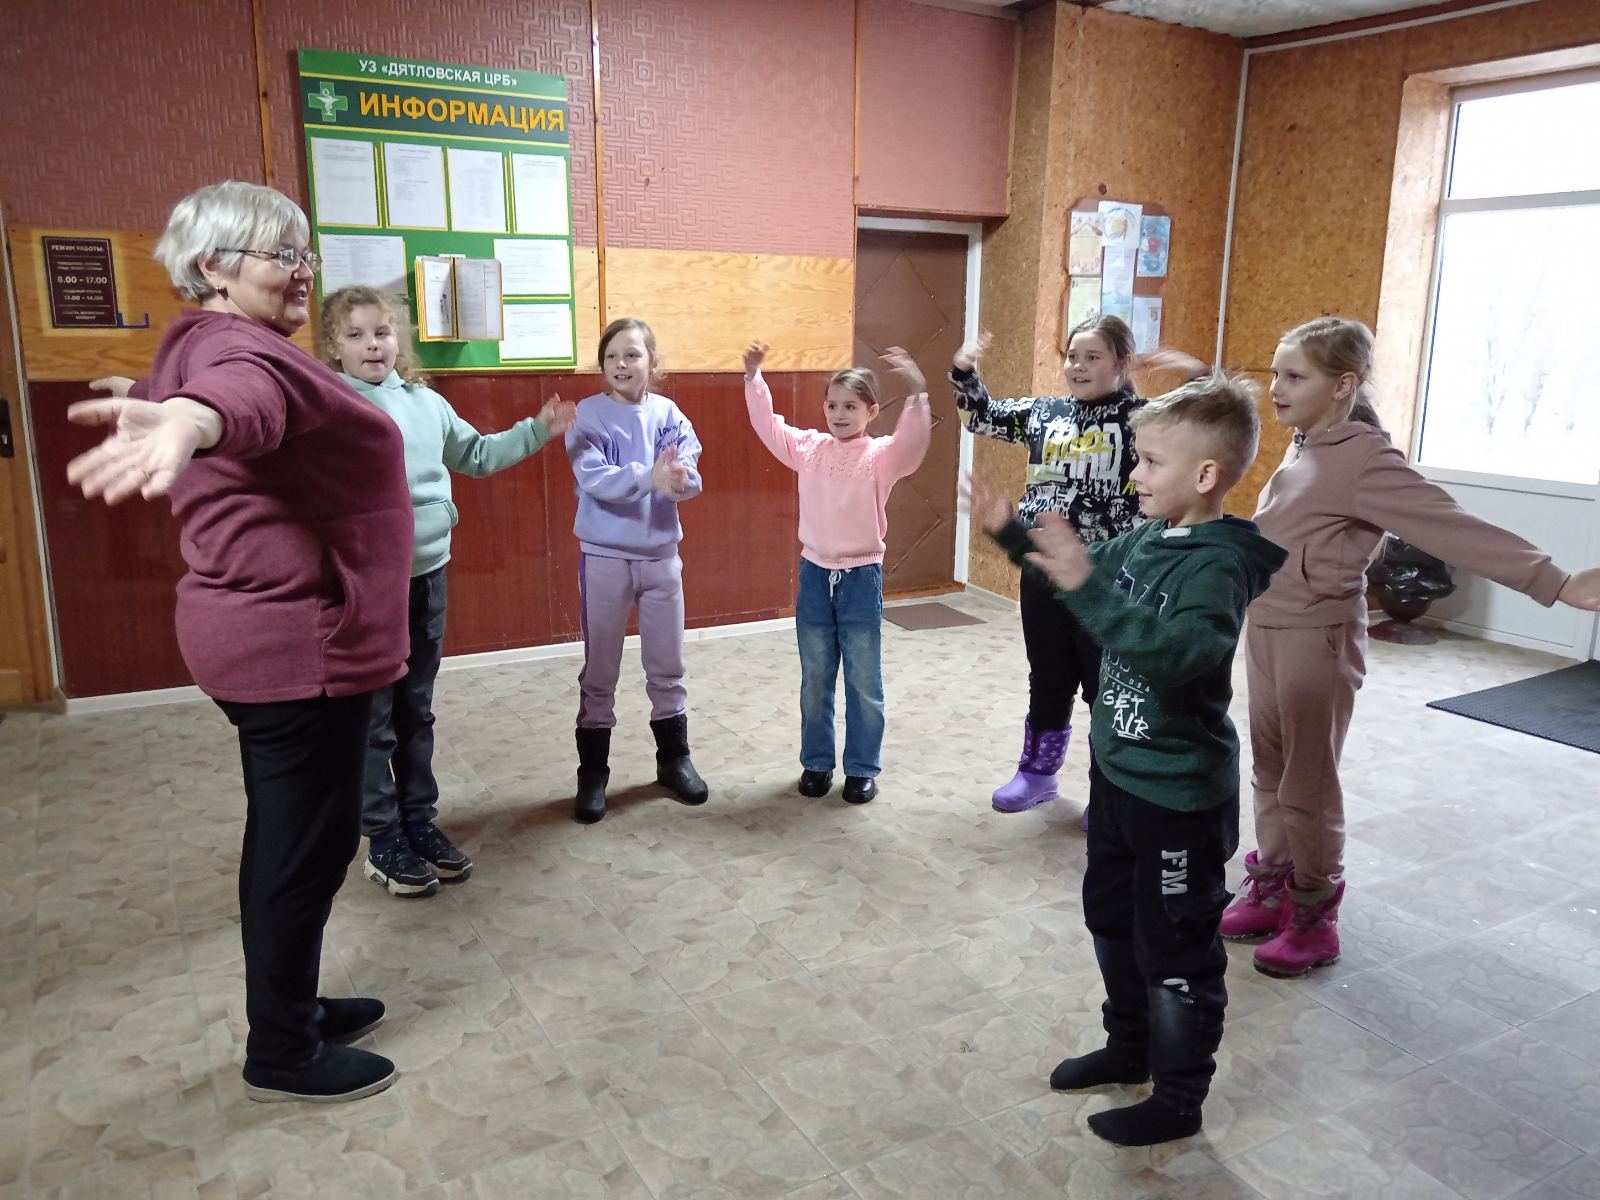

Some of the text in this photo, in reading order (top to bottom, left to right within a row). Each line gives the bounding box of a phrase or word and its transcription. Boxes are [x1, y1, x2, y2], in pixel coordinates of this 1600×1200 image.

[359, 59, 518, 87] УЗ «ДЯТЛОВСКАЯ ЦРБ»
[359, 91, 565, 133] ИНФОРМАЦИЯ
[85, 276, 108, 285] 17.00
[1102, 689, 1145, 717] GET
[1111, 708, 1152, 740] AIR
[1161, 850, 1188, 895] FM
